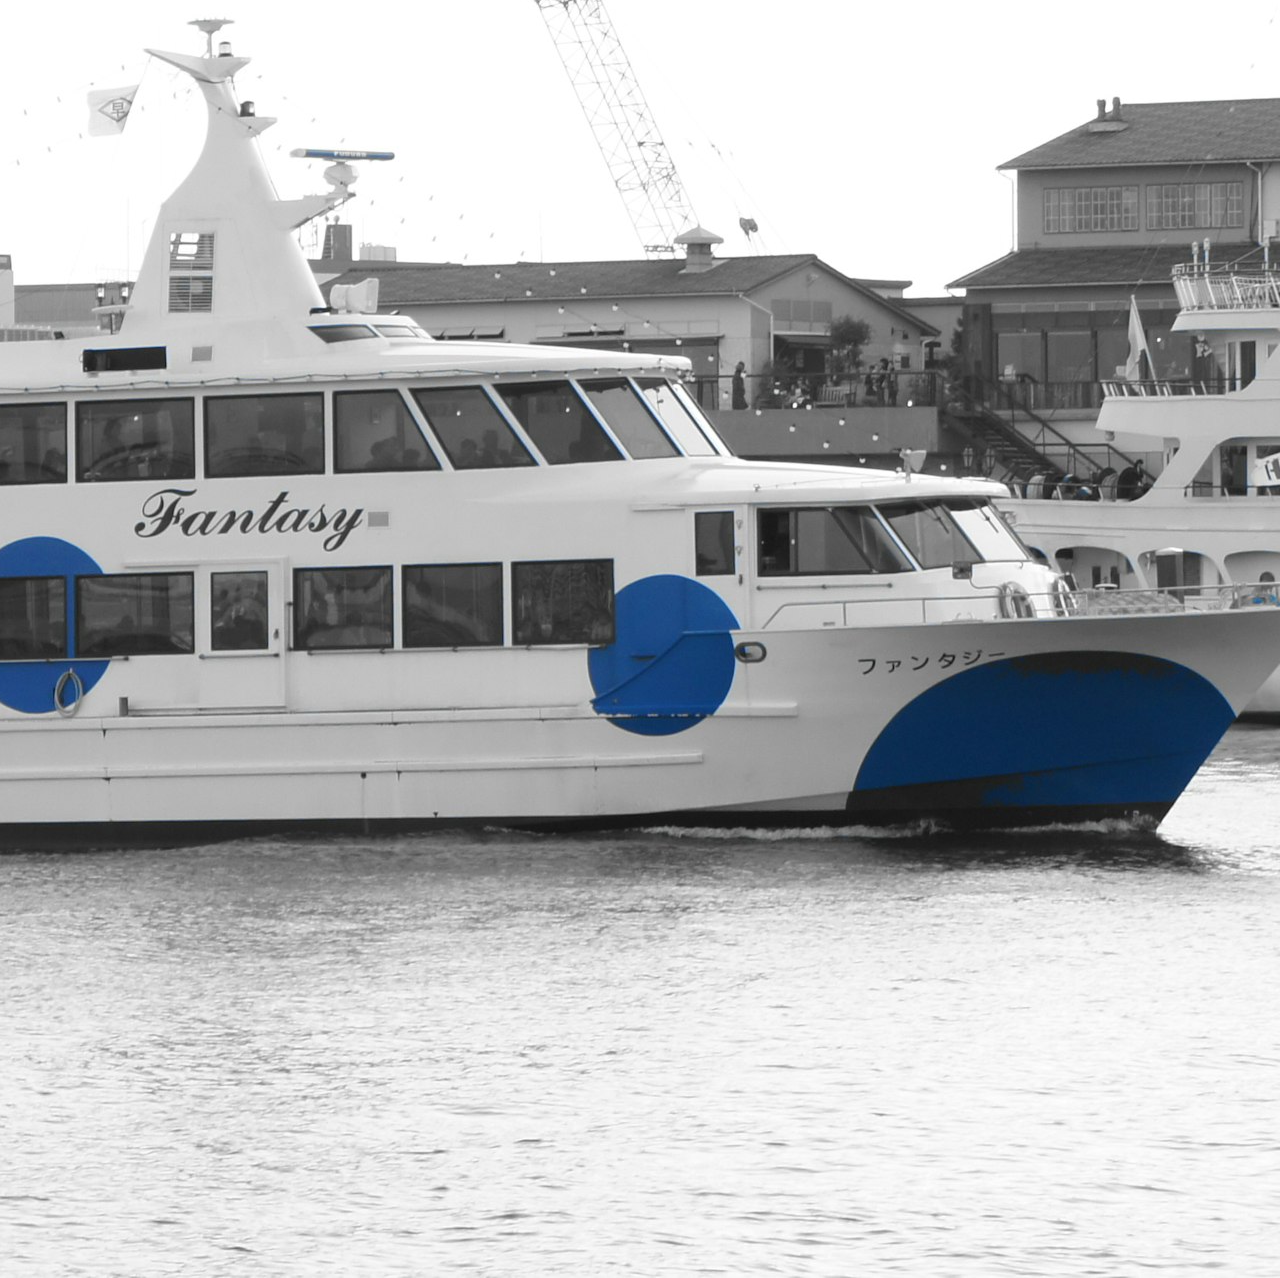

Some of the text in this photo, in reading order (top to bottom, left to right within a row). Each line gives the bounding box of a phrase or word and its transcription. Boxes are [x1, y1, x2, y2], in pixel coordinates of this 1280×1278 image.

[134, 488, 364, 552] Fantasy
[858, 649, 1006, 675] ファンタジー
